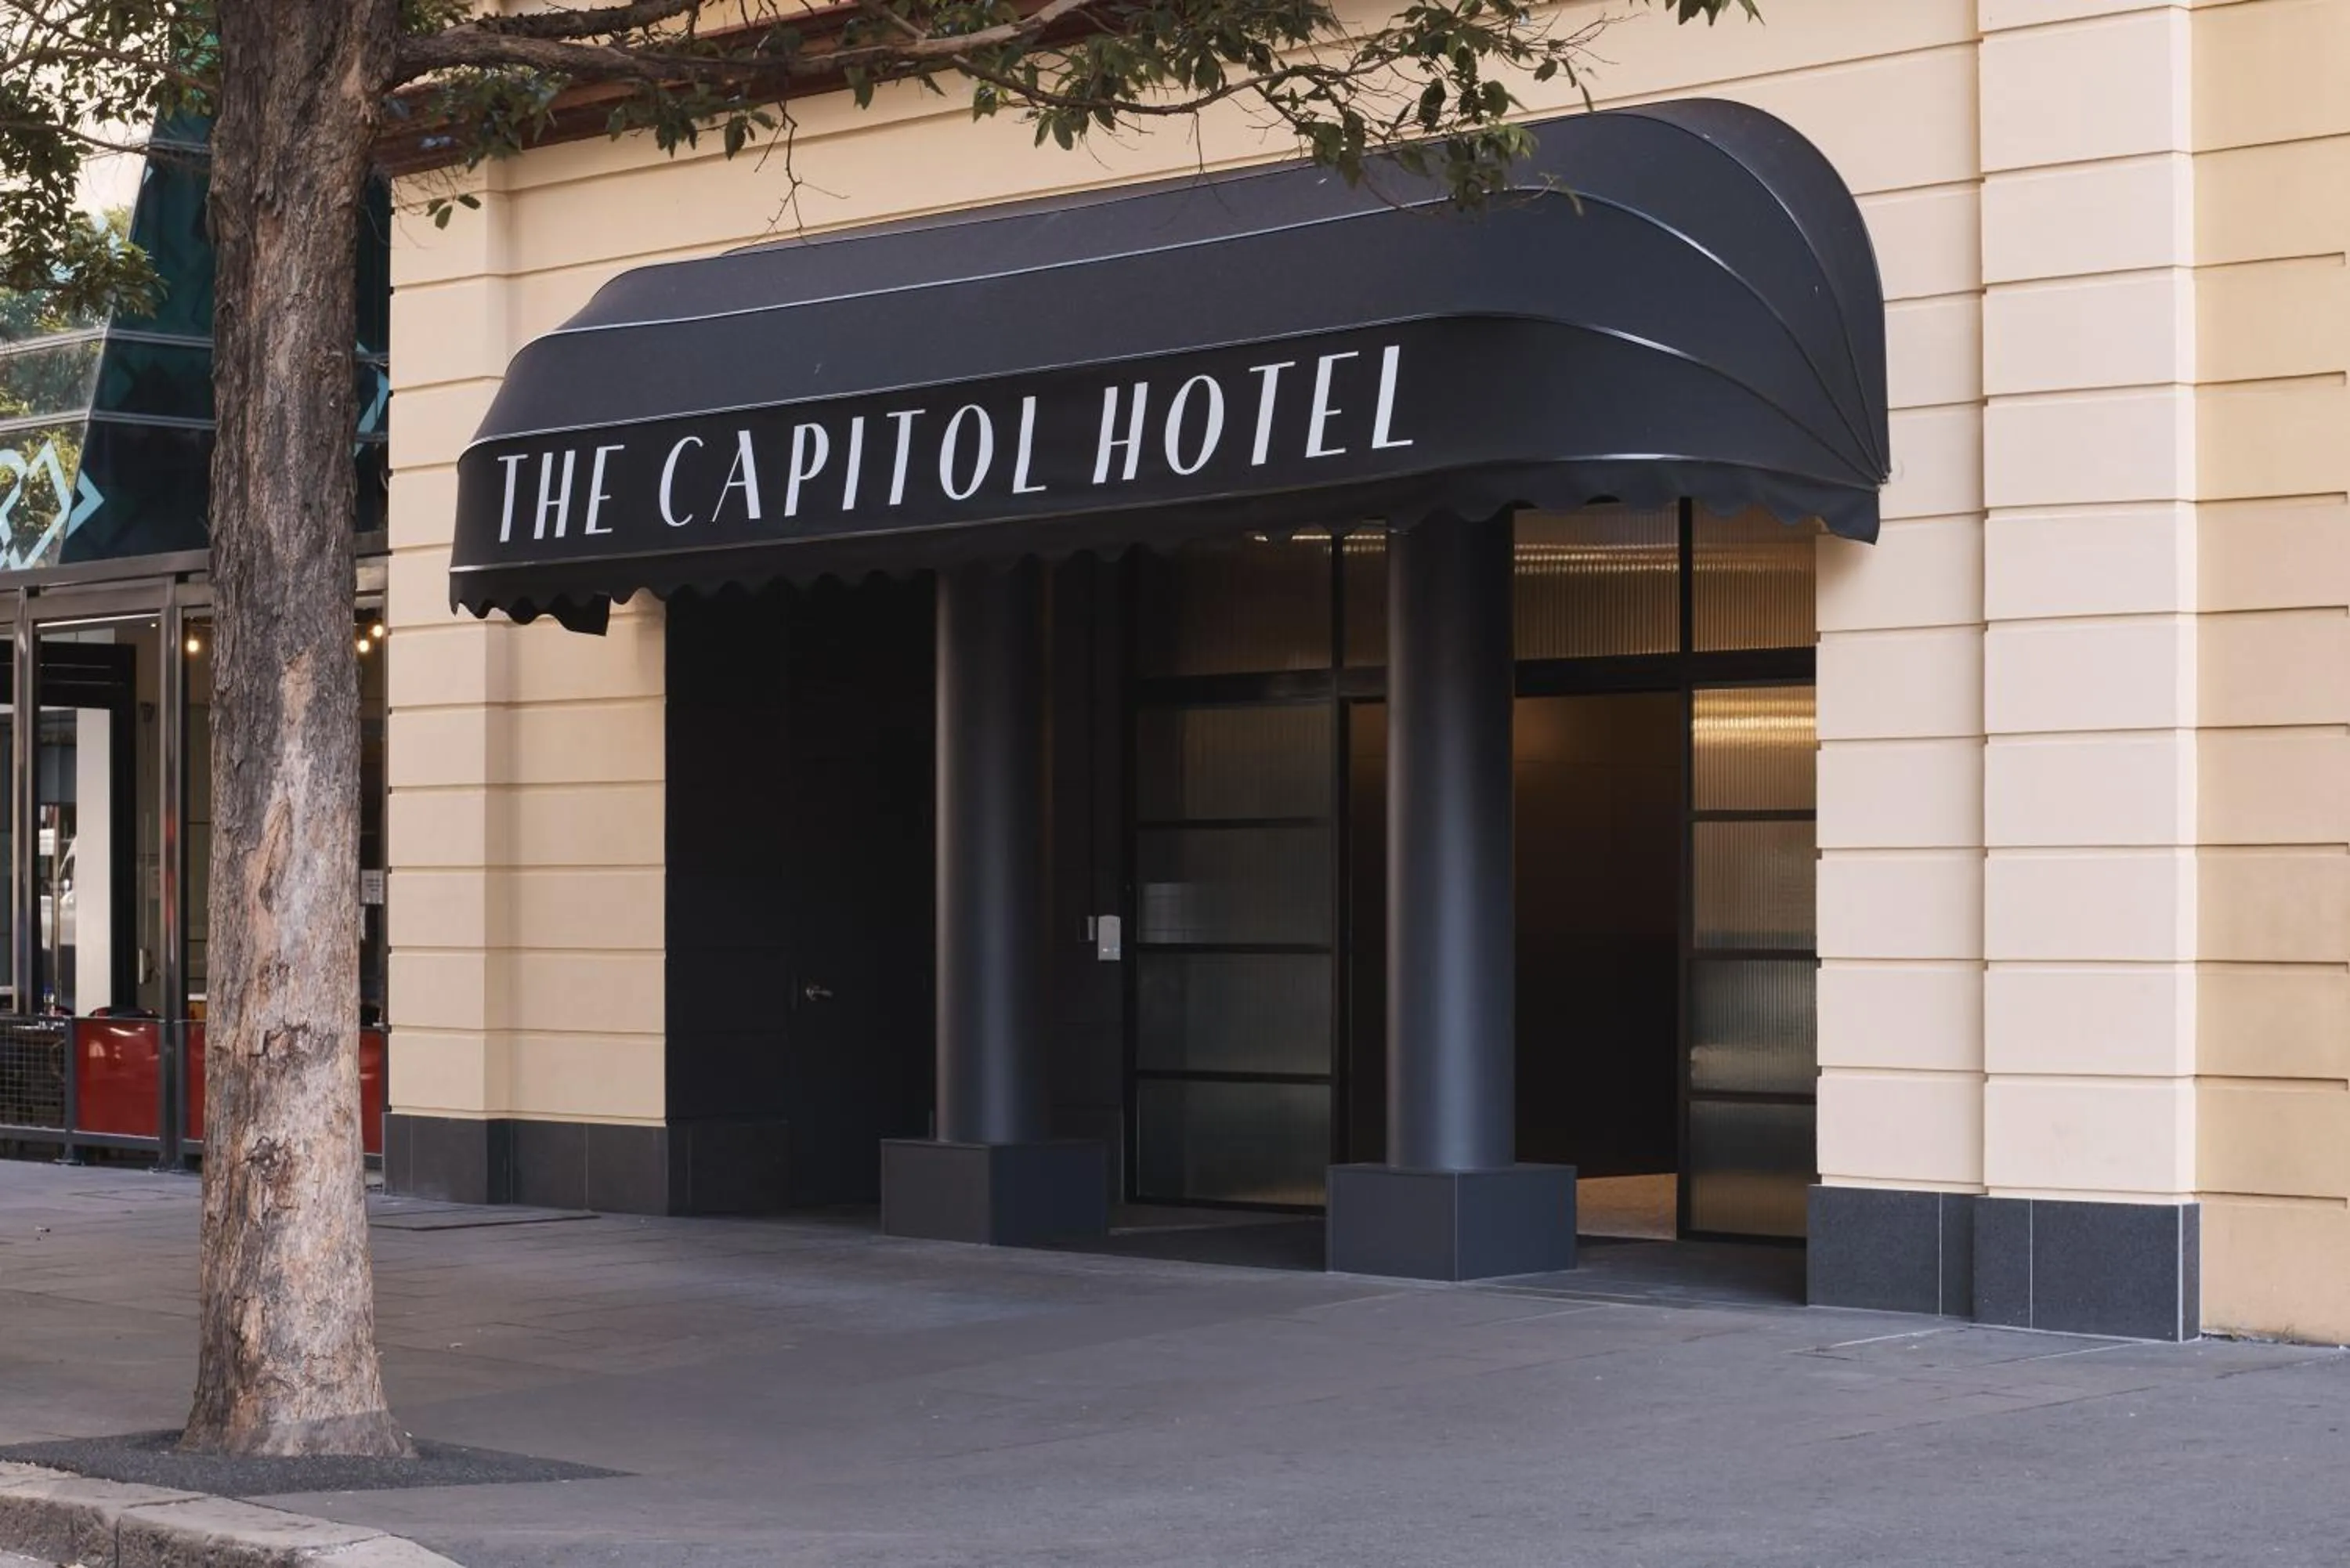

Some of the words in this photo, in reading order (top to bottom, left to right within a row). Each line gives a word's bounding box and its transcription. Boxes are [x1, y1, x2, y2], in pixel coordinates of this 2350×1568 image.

[497, 443, 625, 543] THE
[658, 396, 1047, 527] CAPITOL
[1092, 345, 1414, 485] HOTEL
